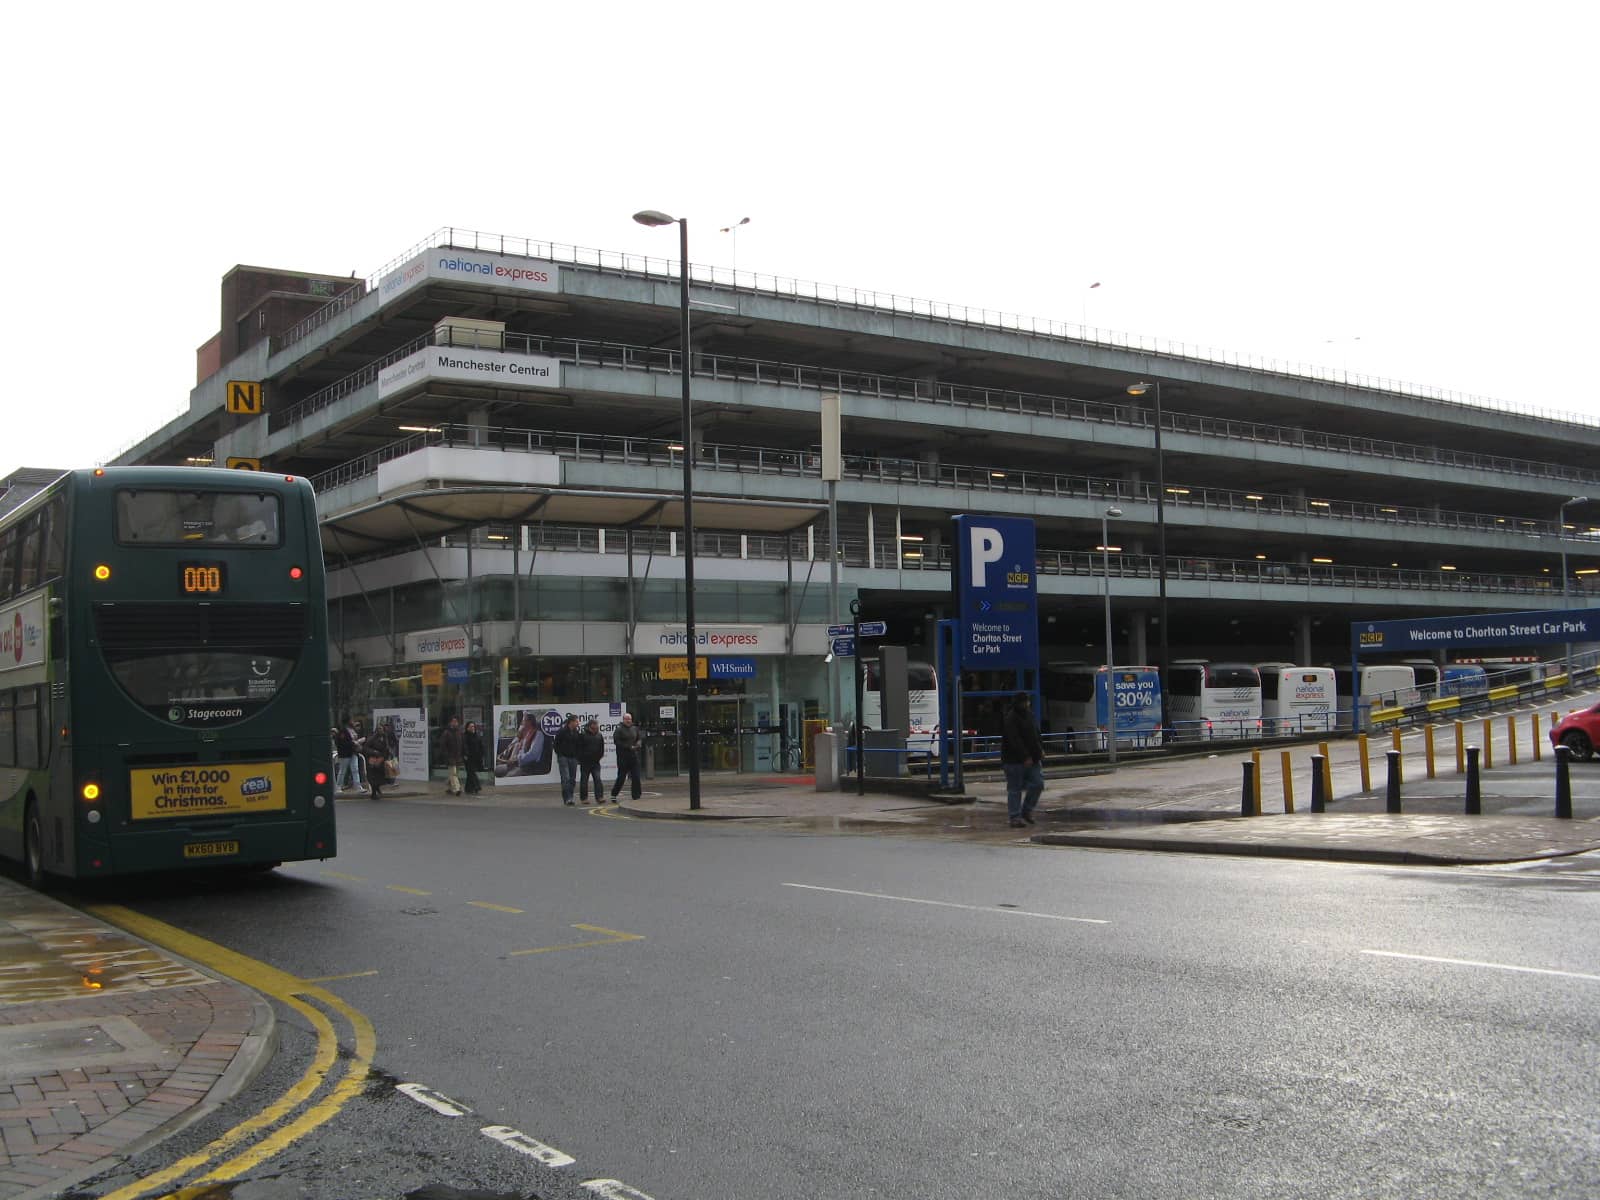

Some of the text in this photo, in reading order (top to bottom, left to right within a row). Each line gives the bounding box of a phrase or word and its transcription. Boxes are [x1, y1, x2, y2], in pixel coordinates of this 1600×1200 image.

[439, 257, 548, 282] national express
[438, 356, 550, 377] Manchester Central
[233, 384, 255, 411] N
[970, 526, 1004, 588] P
[1008, 572, 1029, 584] NCP
[972, 624, 1010, 632] Welcome to
[1410, 621, 1587, 641] Welcome to Chorlton Street Car Park
[659, 632, 758, 648] natial express
[972, 634, 1022, 643] Chorlton Street
[972, 645, 1001, 654] Car Park
[712, 663, 753, 673] WHSmith
[1138, 681, 1154, 691] you
[1295, 685, 1325, 693] national
[1116, 691, 1153, 707] 30%
[187, 708, 243, 720] Stagecoach
[565, 712, 599, 721] Snior
[543, 716, 562, 726] £10
[152, 770, 230, 786] Win £1,000
[243, 777, 268, 791] real
[164, 784, 218, 794] in time for
[155, 795, 228, 808] Christmas.
